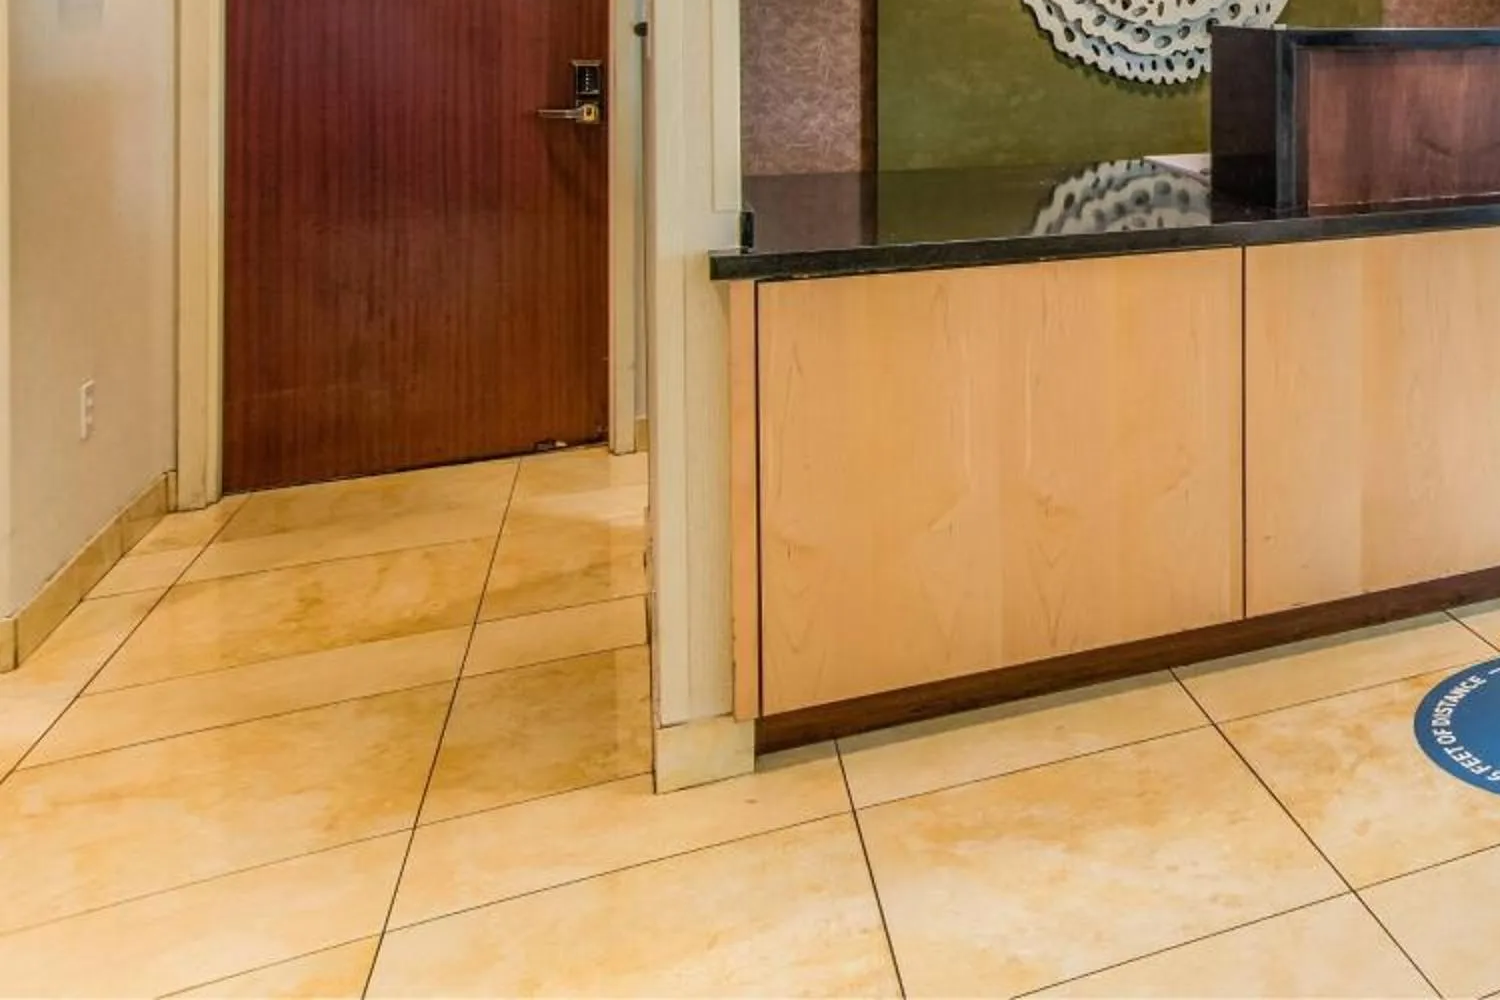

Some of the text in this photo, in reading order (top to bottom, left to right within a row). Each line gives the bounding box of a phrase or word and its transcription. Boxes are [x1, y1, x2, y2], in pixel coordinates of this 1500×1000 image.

[1431, 674, 1488, 727] DISTANCE
[1431, 728, 1457, 745] OF
[1443, 746, 1493, 775] FEET
